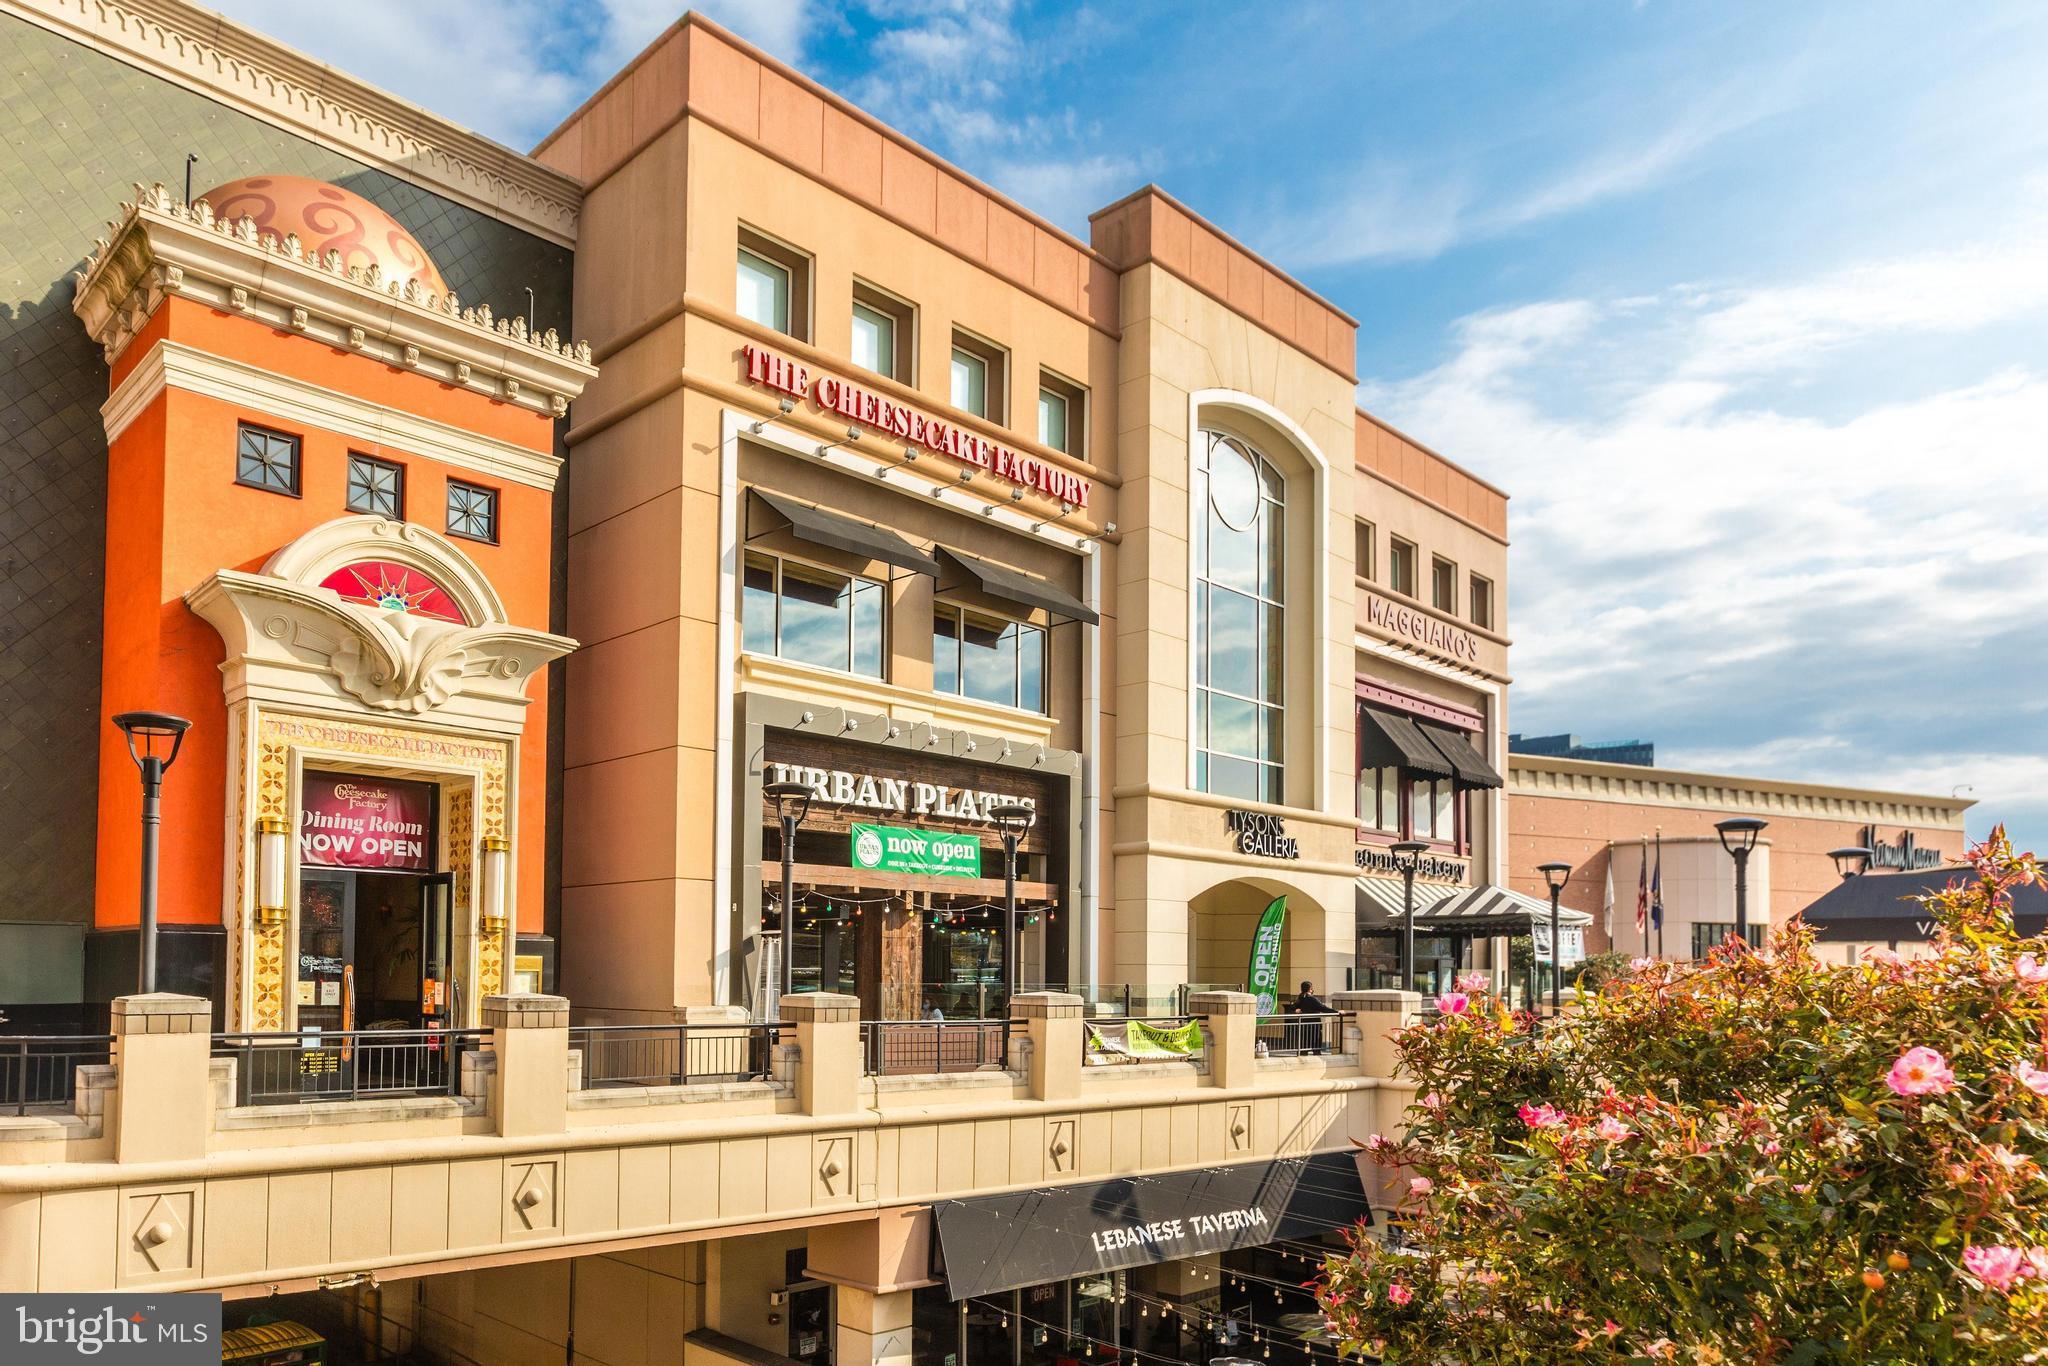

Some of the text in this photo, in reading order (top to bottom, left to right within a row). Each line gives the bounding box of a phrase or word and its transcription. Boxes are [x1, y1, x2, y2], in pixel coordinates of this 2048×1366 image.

[743, 345, 1092, 508] THE CHEESECAKE FACTORY
[1367, 595, 1477, 662] MAGGIANO'S
[265, 720, 503, 761] THE CHEESECAKE FACTORY
[334, 784, 388, 800] Cheesecake
[348, 798, 387, 812] Factory
[771, 763, 1037, 827] URBAN PLATES
[300, 810, 423, 836] Dining Room
[1230, 810, 1284, 836] TYSONS
[300, 833, 422, 857] NOW OPEN
[887, 837, 976, 862] now open
[1241, 831, 1299, 858] GALLERIA
[1416, 856, 1465, 884] bakery
[1916, 922, 1941, 935] VA
[1255, 926, 1273, 987] OPEN
[1272, 923, 1281, 963] DINING
[1091, 1207, 1268, 1251] LEBANESE TAVERNA
